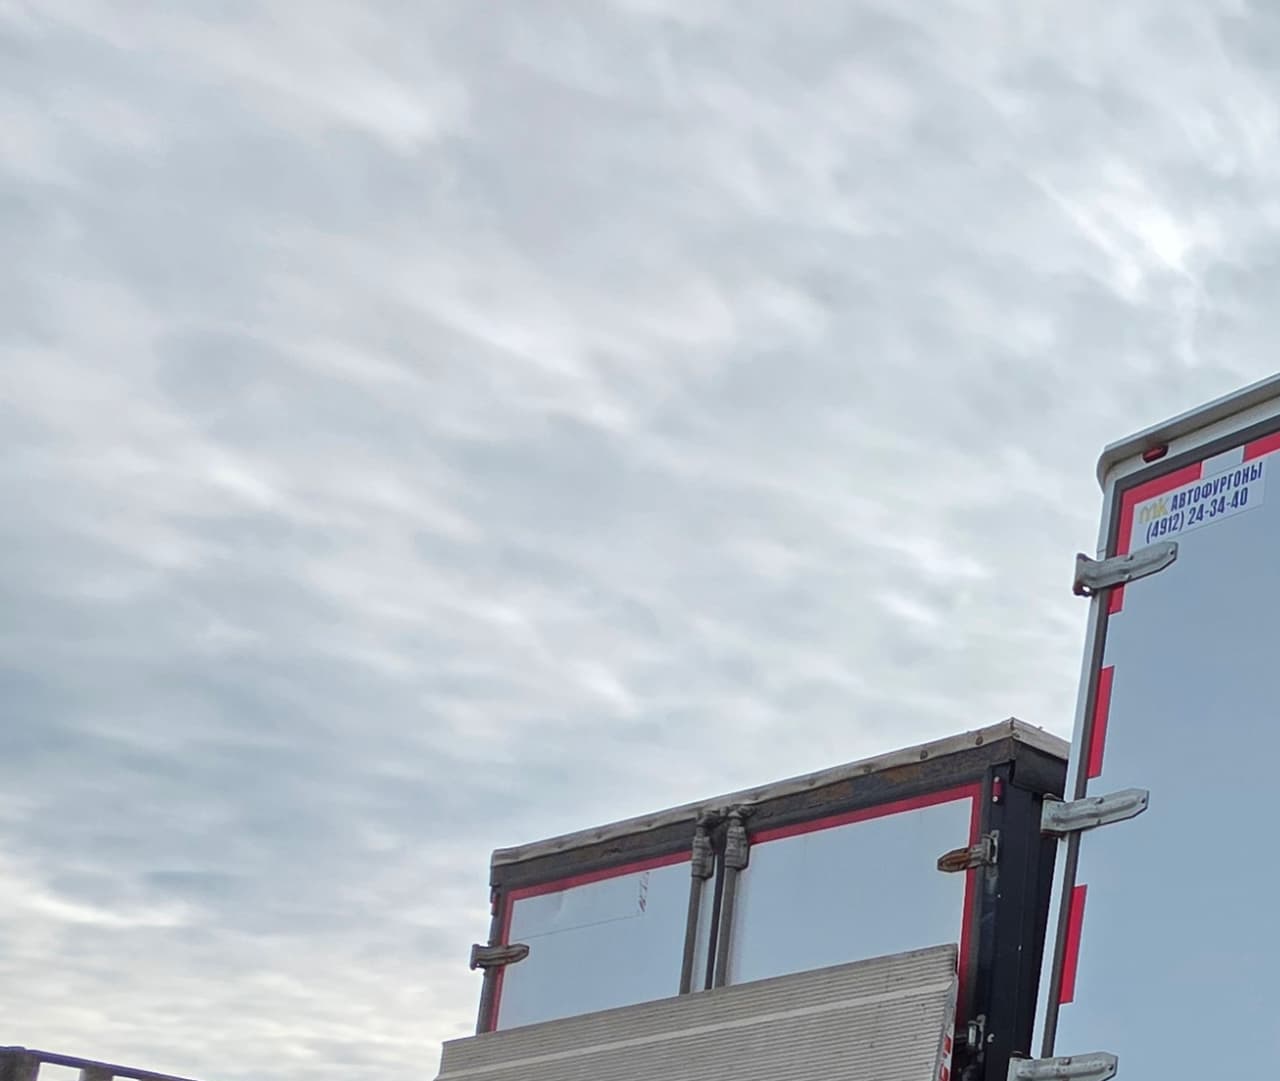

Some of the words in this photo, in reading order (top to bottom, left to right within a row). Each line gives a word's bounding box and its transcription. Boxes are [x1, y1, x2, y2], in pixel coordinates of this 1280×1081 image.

[1171, 462, 1263, 511] АВТОФУРГОНЫ
[1146, 512, 1185, 544] (4912)
[1188, 487, 1248, 525] 24-34-40
